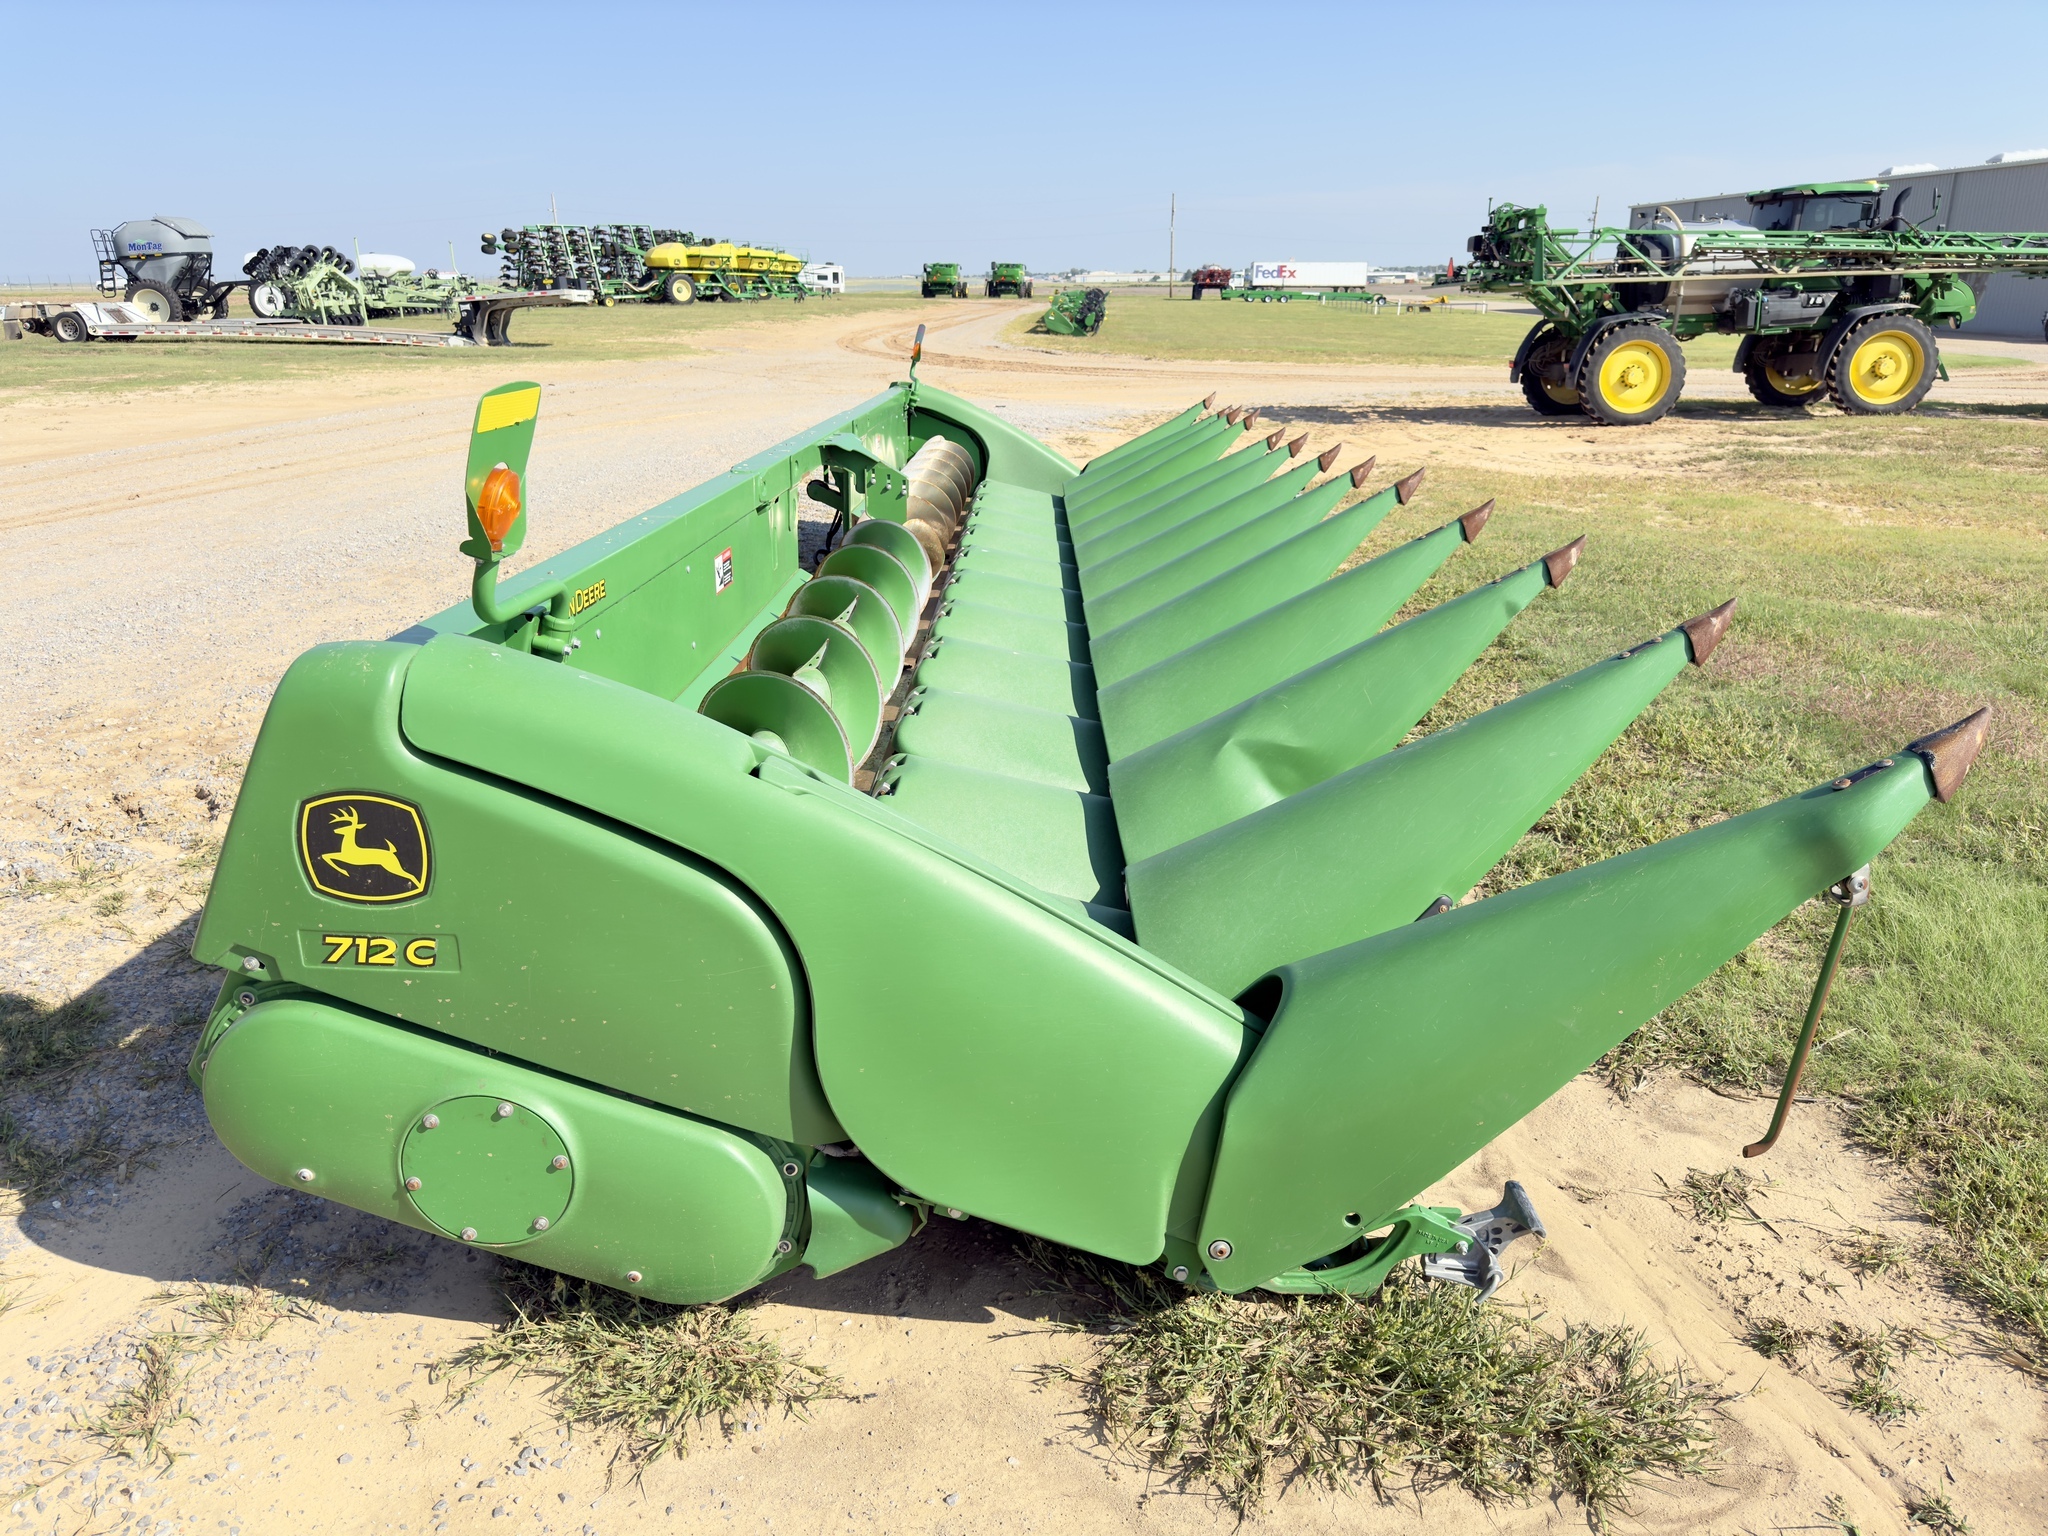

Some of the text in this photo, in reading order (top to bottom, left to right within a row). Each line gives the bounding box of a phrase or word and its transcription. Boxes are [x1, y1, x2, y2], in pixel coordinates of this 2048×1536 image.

[128, 242, 163, 251] MonTag
[1255, 265, 1297, 279] FedEx
[575, 579, 606, 613] DEERE
[323, 935, 437, 968] 712 C
